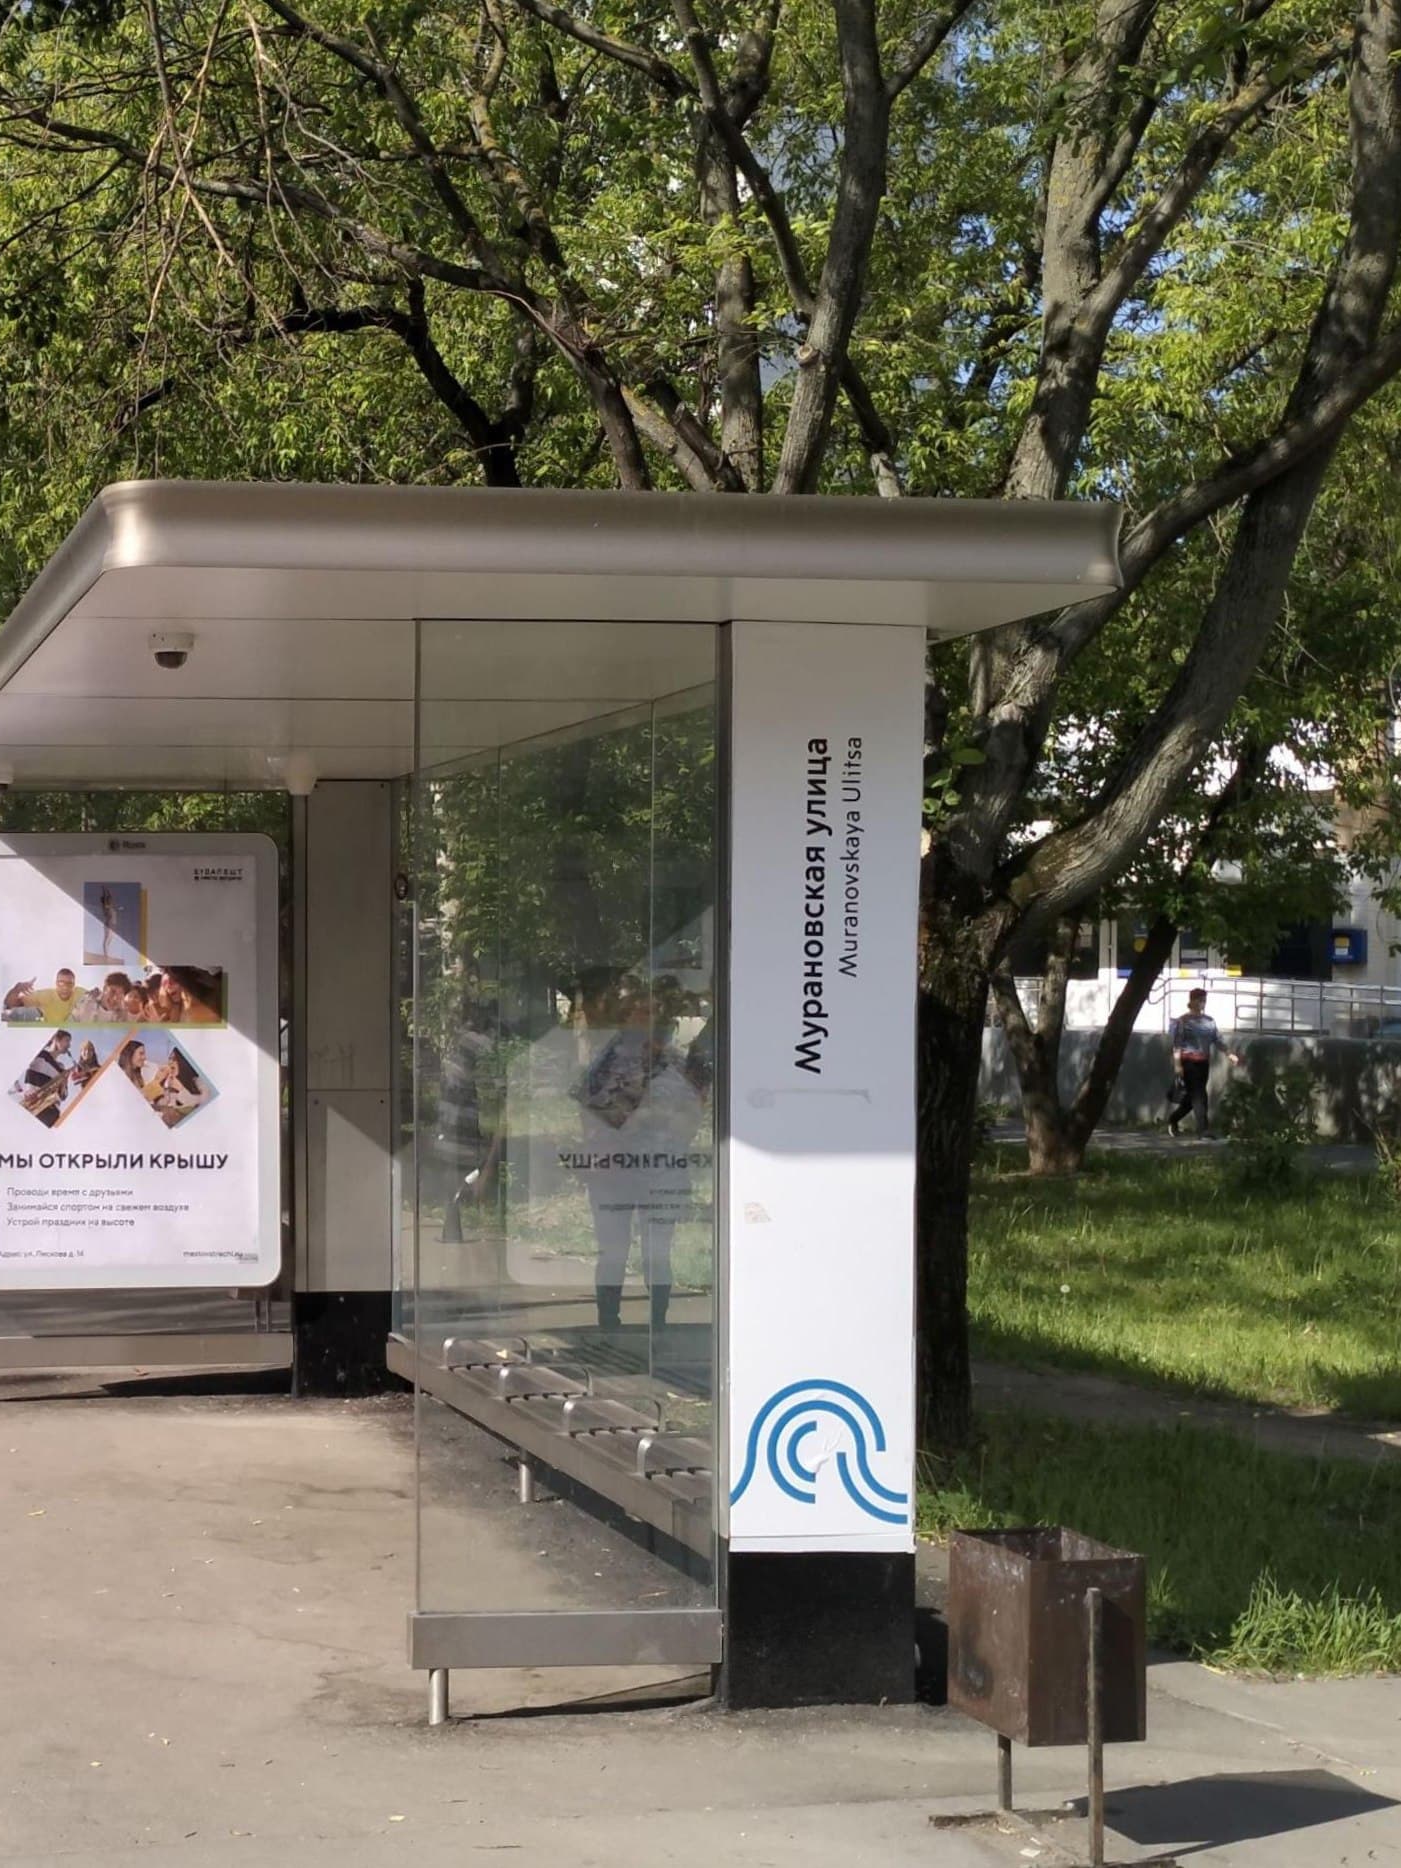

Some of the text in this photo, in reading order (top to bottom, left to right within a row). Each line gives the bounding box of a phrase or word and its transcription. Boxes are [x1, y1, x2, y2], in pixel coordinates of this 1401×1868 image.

[838, 736, 865, 978] Muranovskaya Ulitsa
[794, 736, 833, 1075] Мурановская улица
[39, 1153, 143, 1169] ОТКРЫЛИ
[149, 1153, 228, 1169] КРЫШУ
[7, 1186, 49, 1197] Проводи
[51, 1189, 80, 1197] время
[89, 1189, 133, 1199] друзьями
[7, 1202, 58, 1211] Занимайся
[60, 1204, 100, 1212] спортом
[152, 1204, 189, 1213] воздухе
[7, 1217, 40, 1227] Устрой
[42, 1219, 86, 1228] праздник
